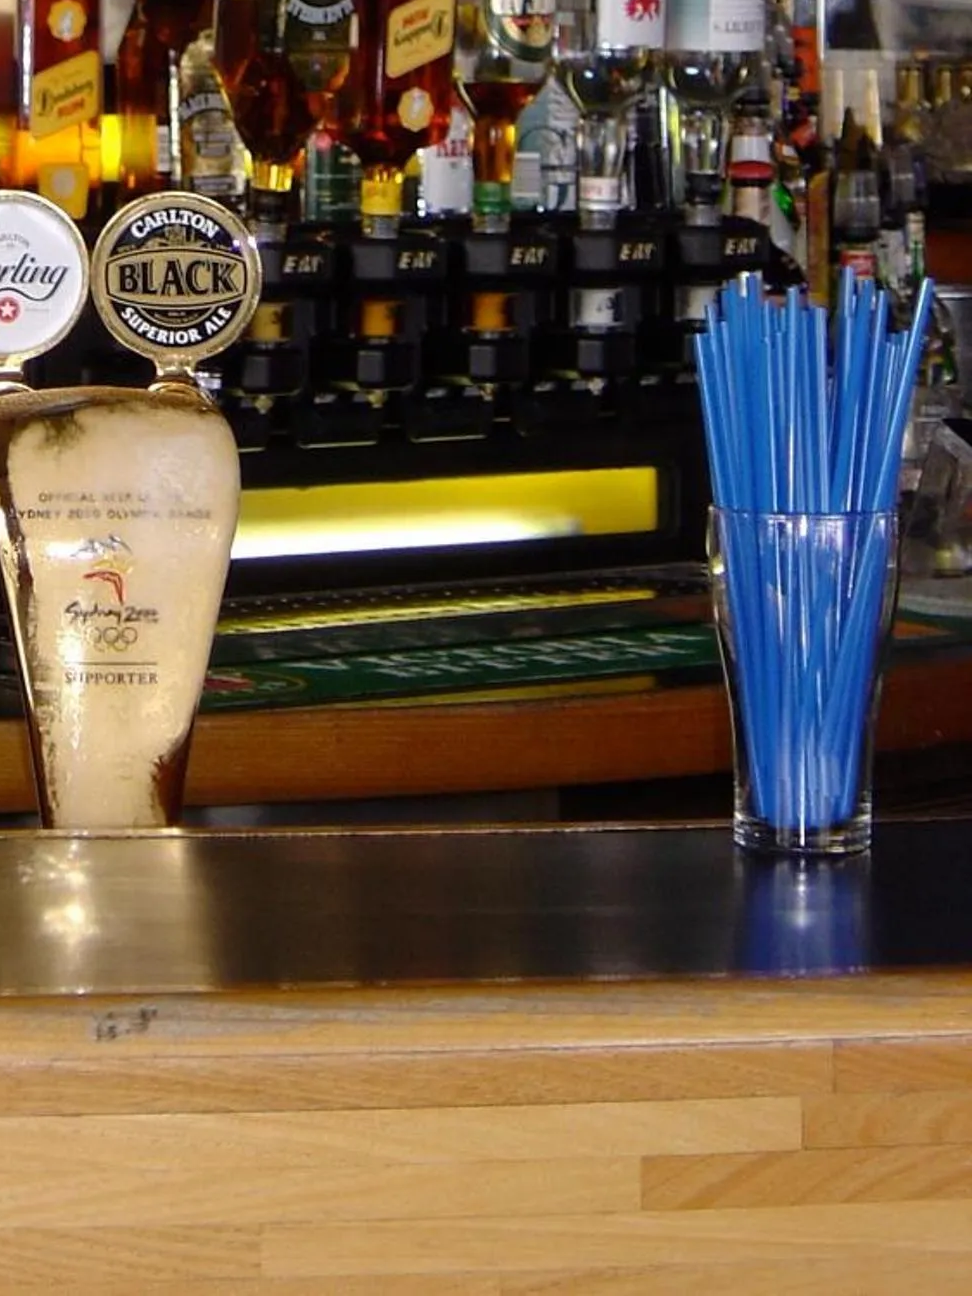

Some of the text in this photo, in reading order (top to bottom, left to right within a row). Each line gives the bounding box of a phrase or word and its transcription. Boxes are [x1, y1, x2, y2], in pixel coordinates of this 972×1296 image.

[130, 208, 220, 239] CARLTON
[118, 257, 239, 298] BLACK
[120, 305, 233, 346] SUPERIOR ALE
